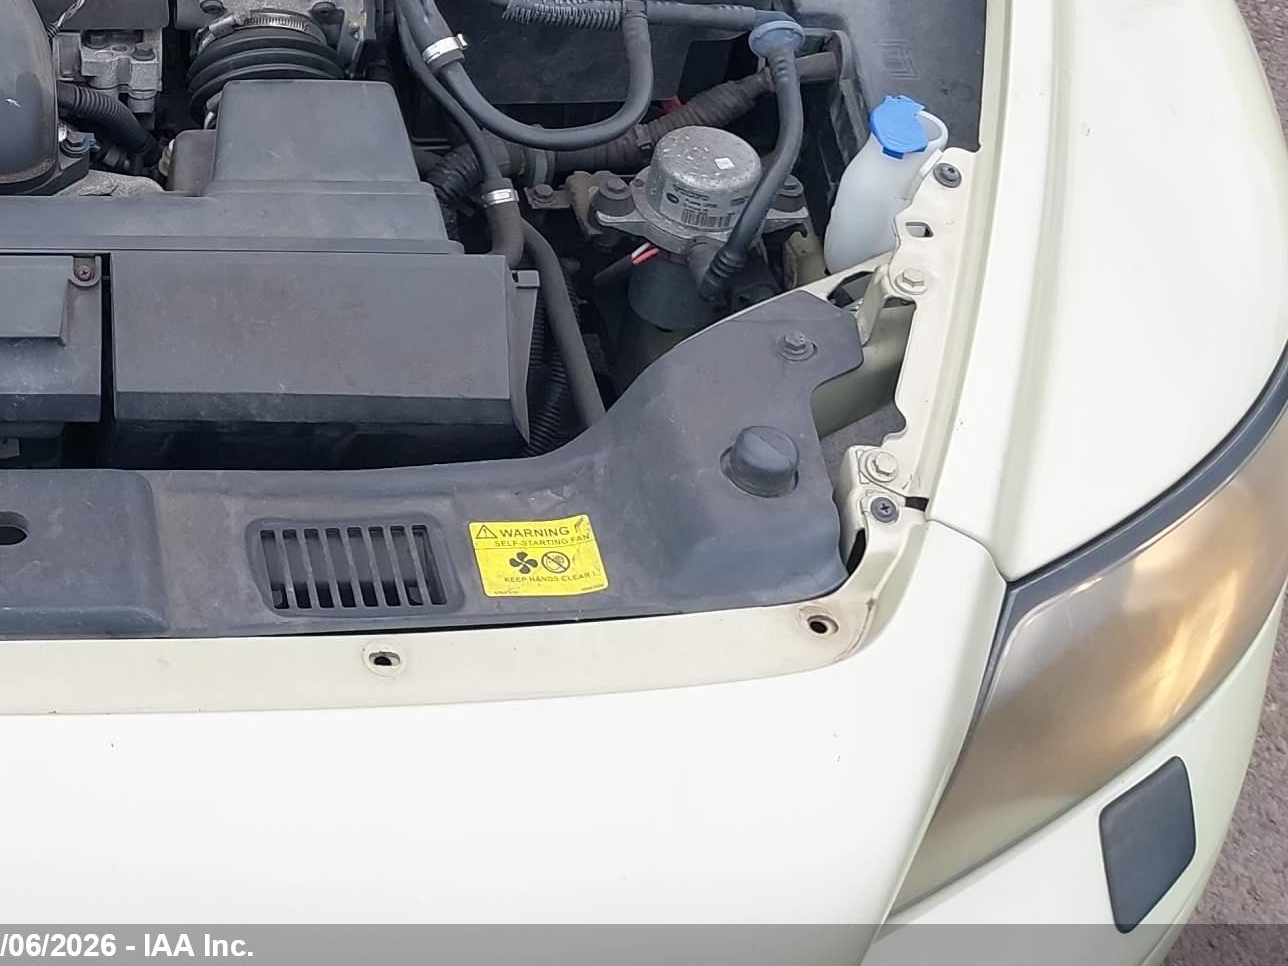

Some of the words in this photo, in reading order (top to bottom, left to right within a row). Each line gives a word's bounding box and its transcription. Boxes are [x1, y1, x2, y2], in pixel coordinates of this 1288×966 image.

[499, 527, 570, 538] WARNING
[494, 539, 569, 547] SELF-STARTING
[571, 534, 590, 544] FAN
[530, 575, 559, 583] HANDS
[561, 573, 590, 582] CLEAR
